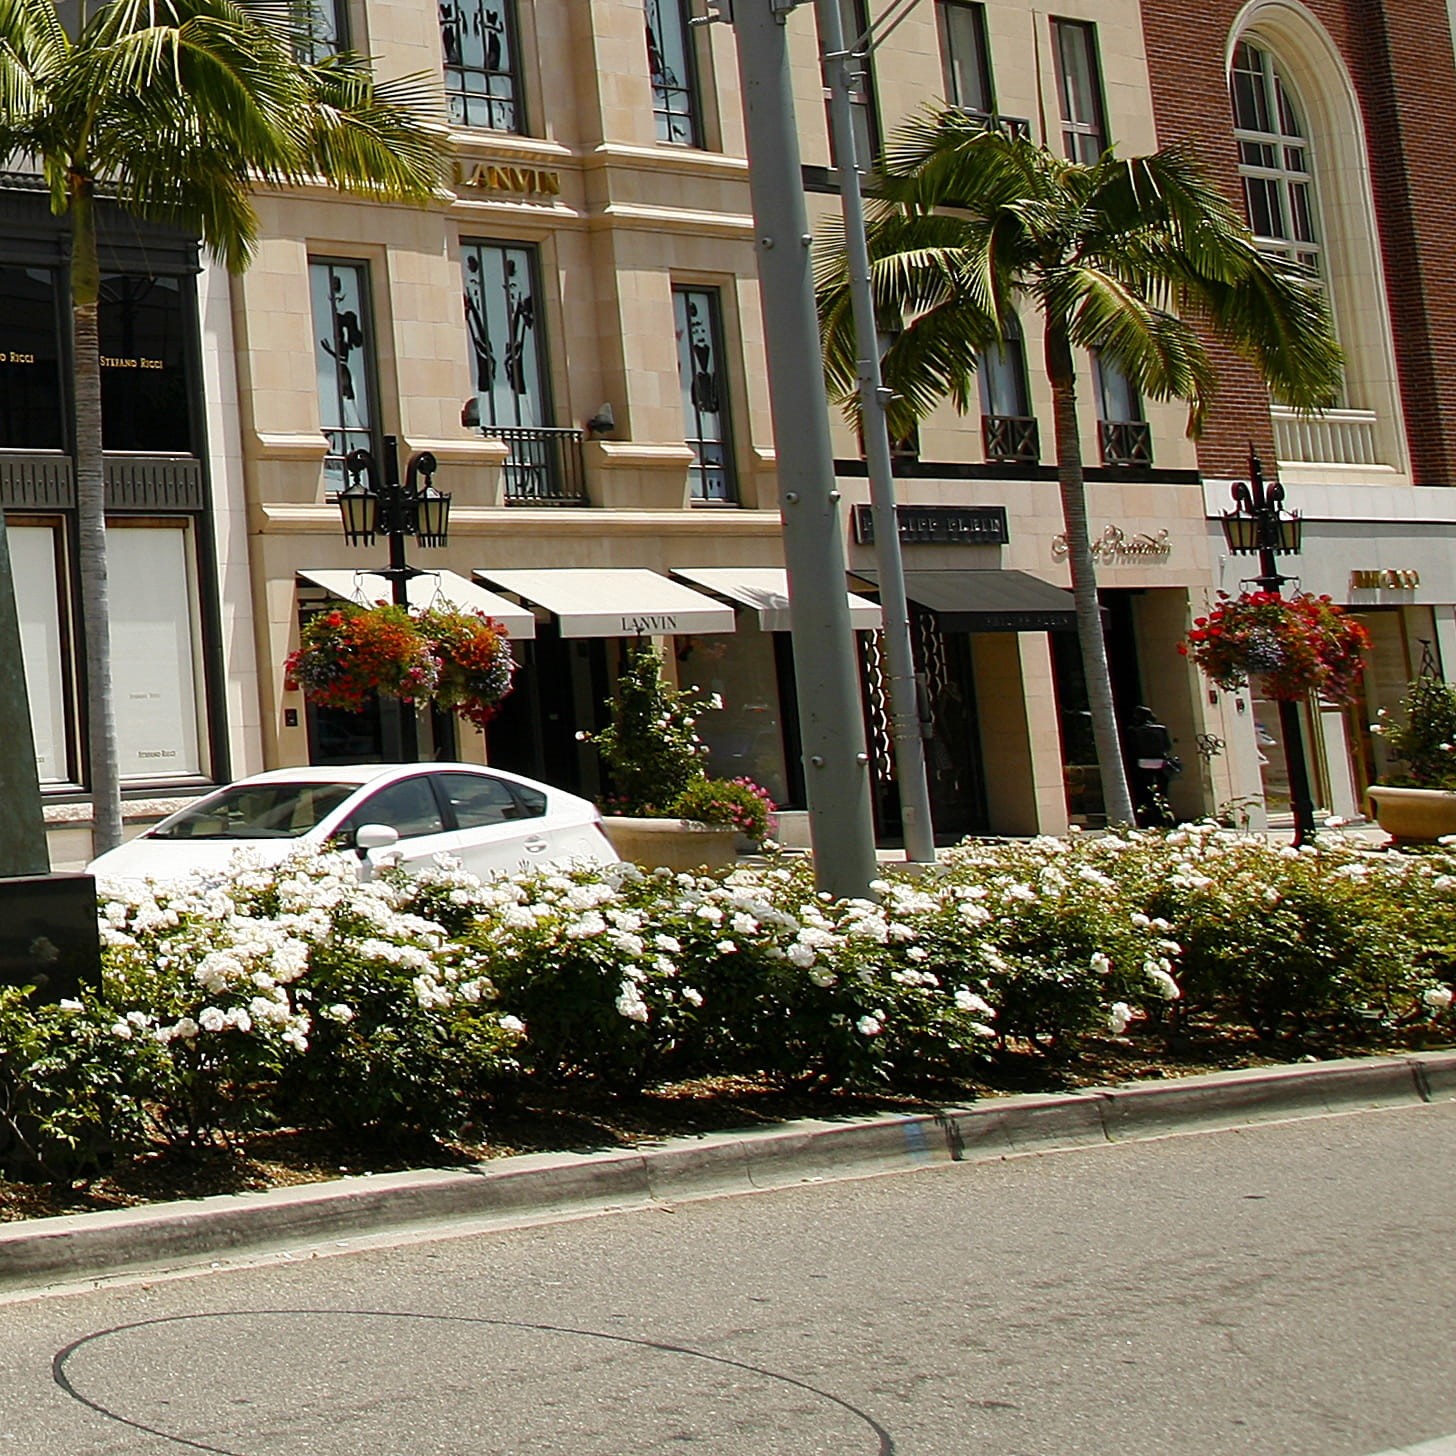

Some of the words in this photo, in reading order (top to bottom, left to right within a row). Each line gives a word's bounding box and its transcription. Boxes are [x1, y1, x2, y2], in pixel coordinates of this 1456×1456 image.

[453, 161, 561, 195] LANVIN
[10, 351, 34, 363] RICCI
[99, 355, 137, 368] STEFANO
[140, 357, 163, 369] RICCI
[621, 616, 676, 631] LANVIN
